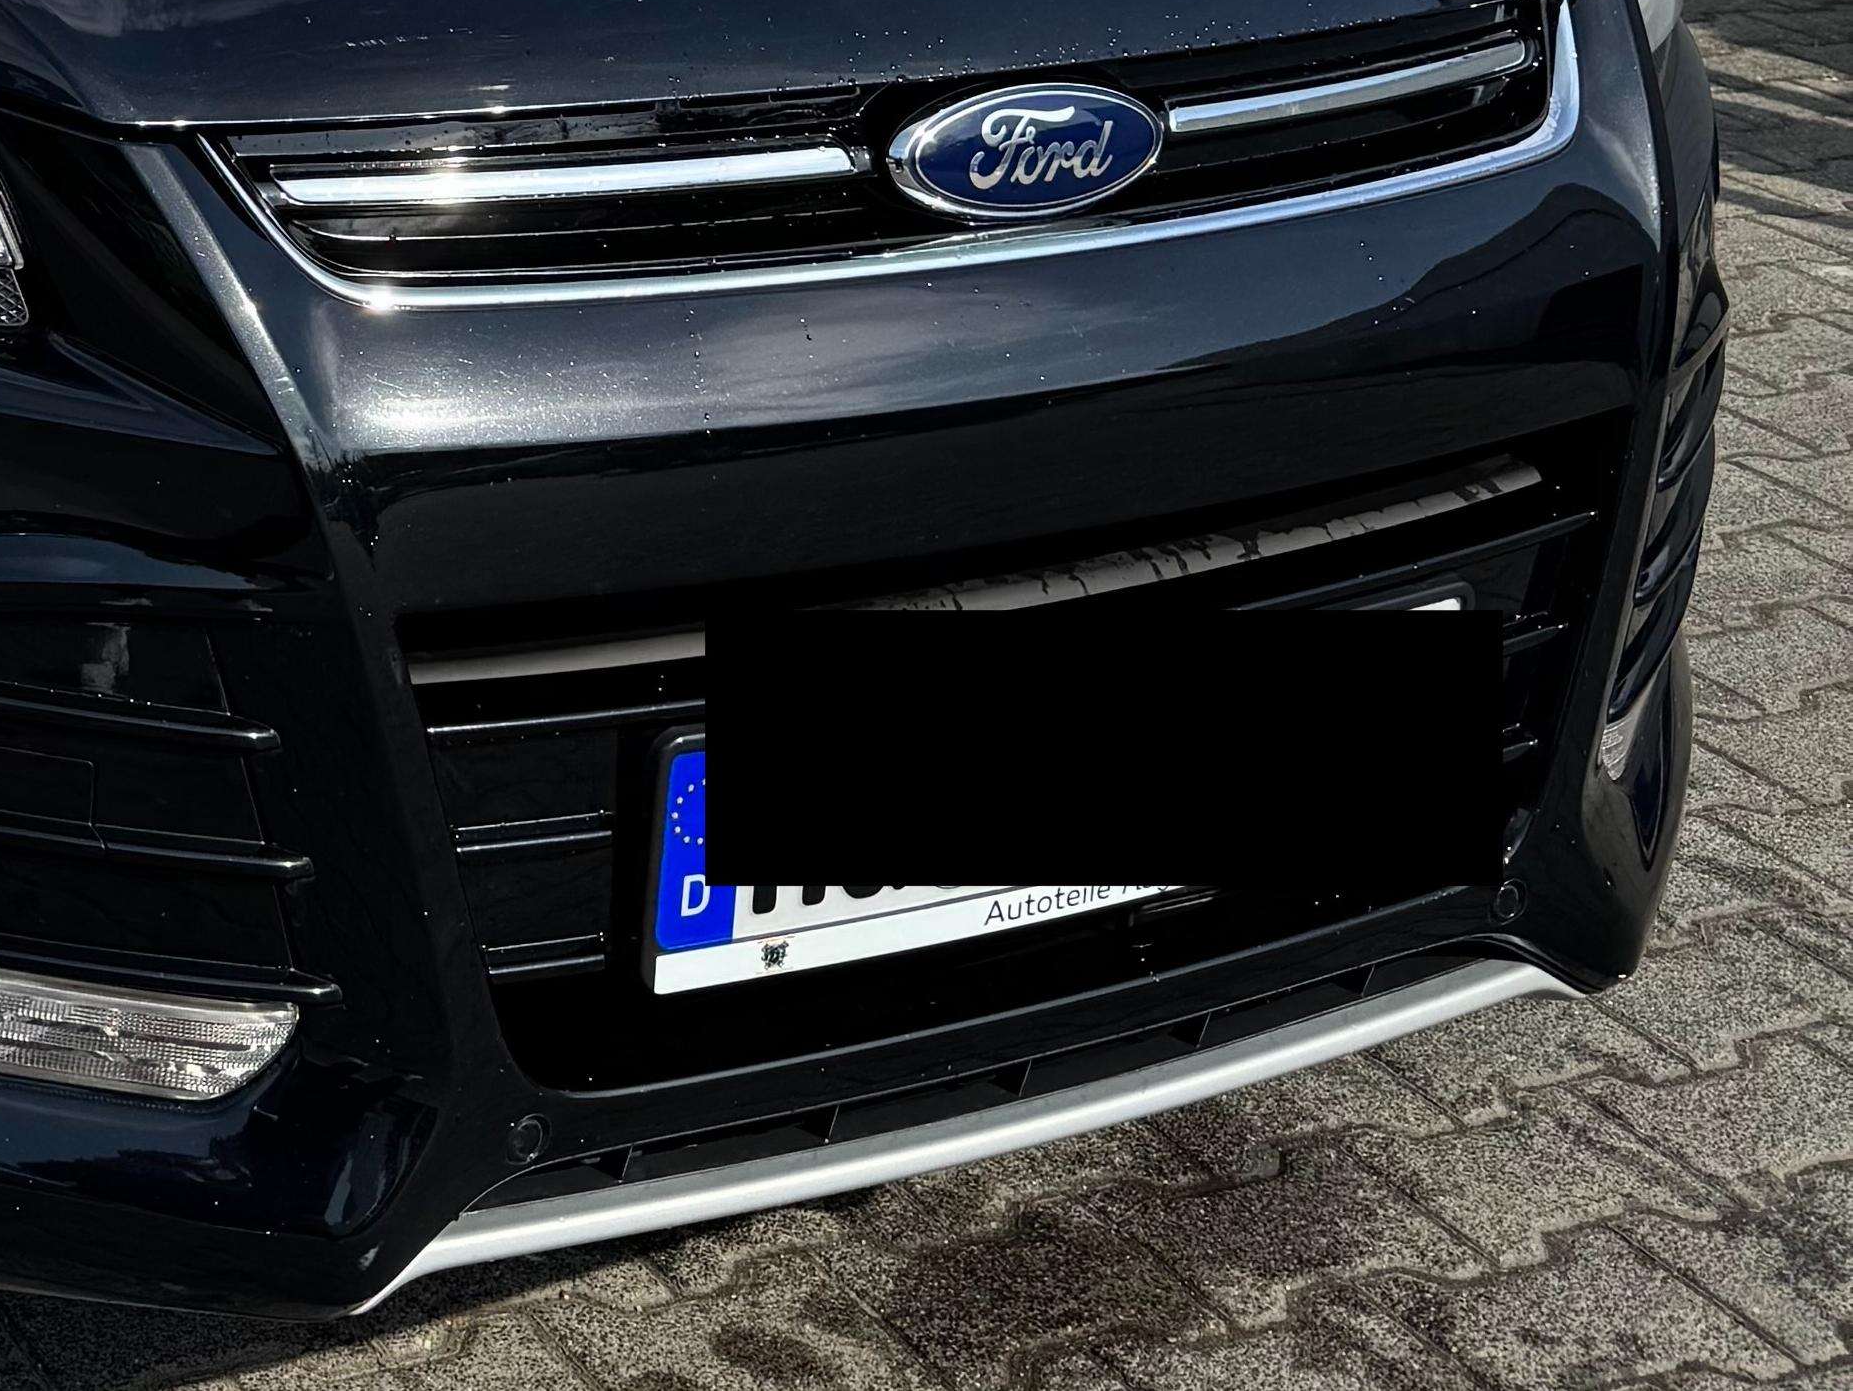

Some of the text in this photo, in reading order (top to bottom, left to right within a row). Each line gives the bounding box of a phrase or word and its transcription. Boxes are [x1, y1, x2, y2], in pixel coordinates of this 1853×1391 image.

[969, 106, 1114, 190] Ford
[681, 873, 711, 917] D
[983, 885, 1110, 926] Autoteile
